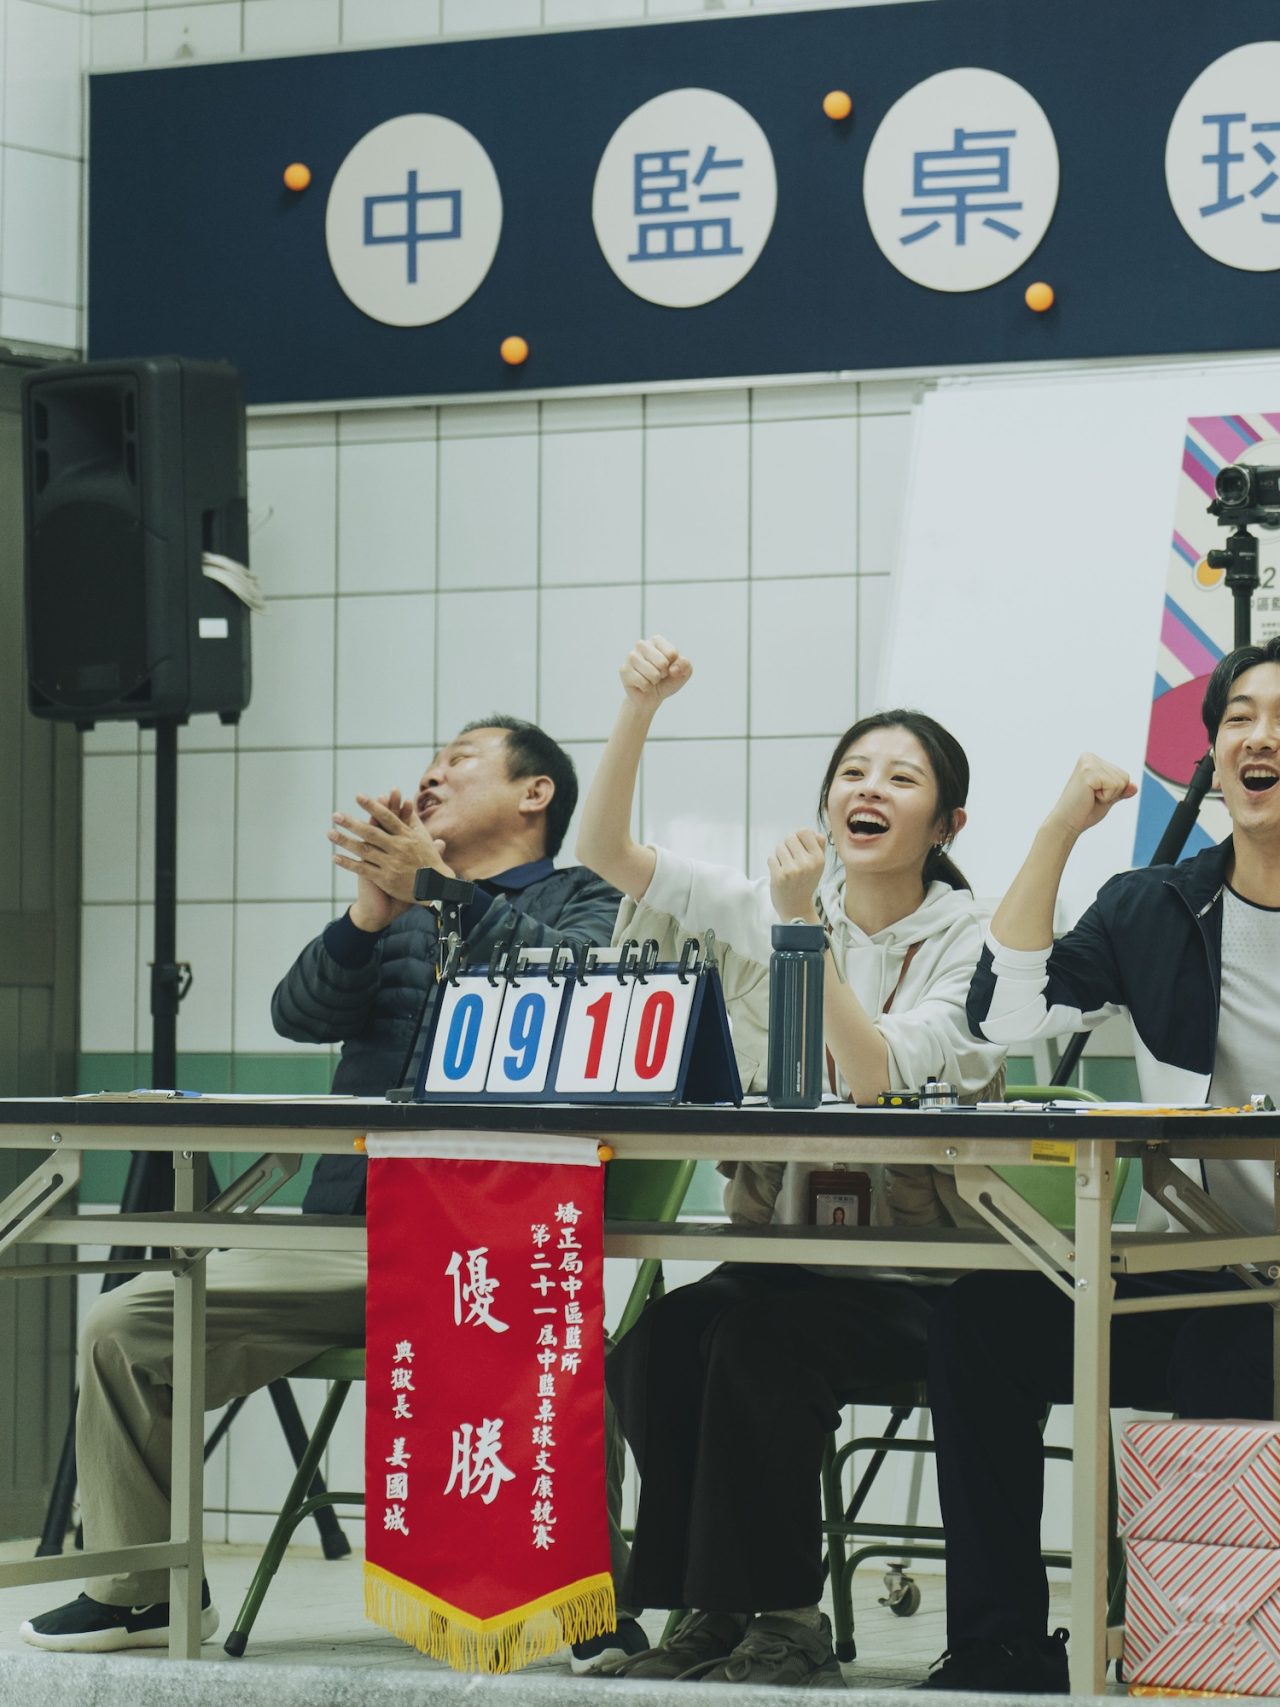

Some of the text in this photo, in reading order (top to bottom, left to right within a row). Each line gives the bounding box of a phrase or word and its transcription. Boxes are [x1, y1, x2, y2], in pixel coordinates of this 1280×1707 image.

[554, 1202, 585, 1376] 矯正局中區監所
[390, 1339, 416, 1420] 典獄長
